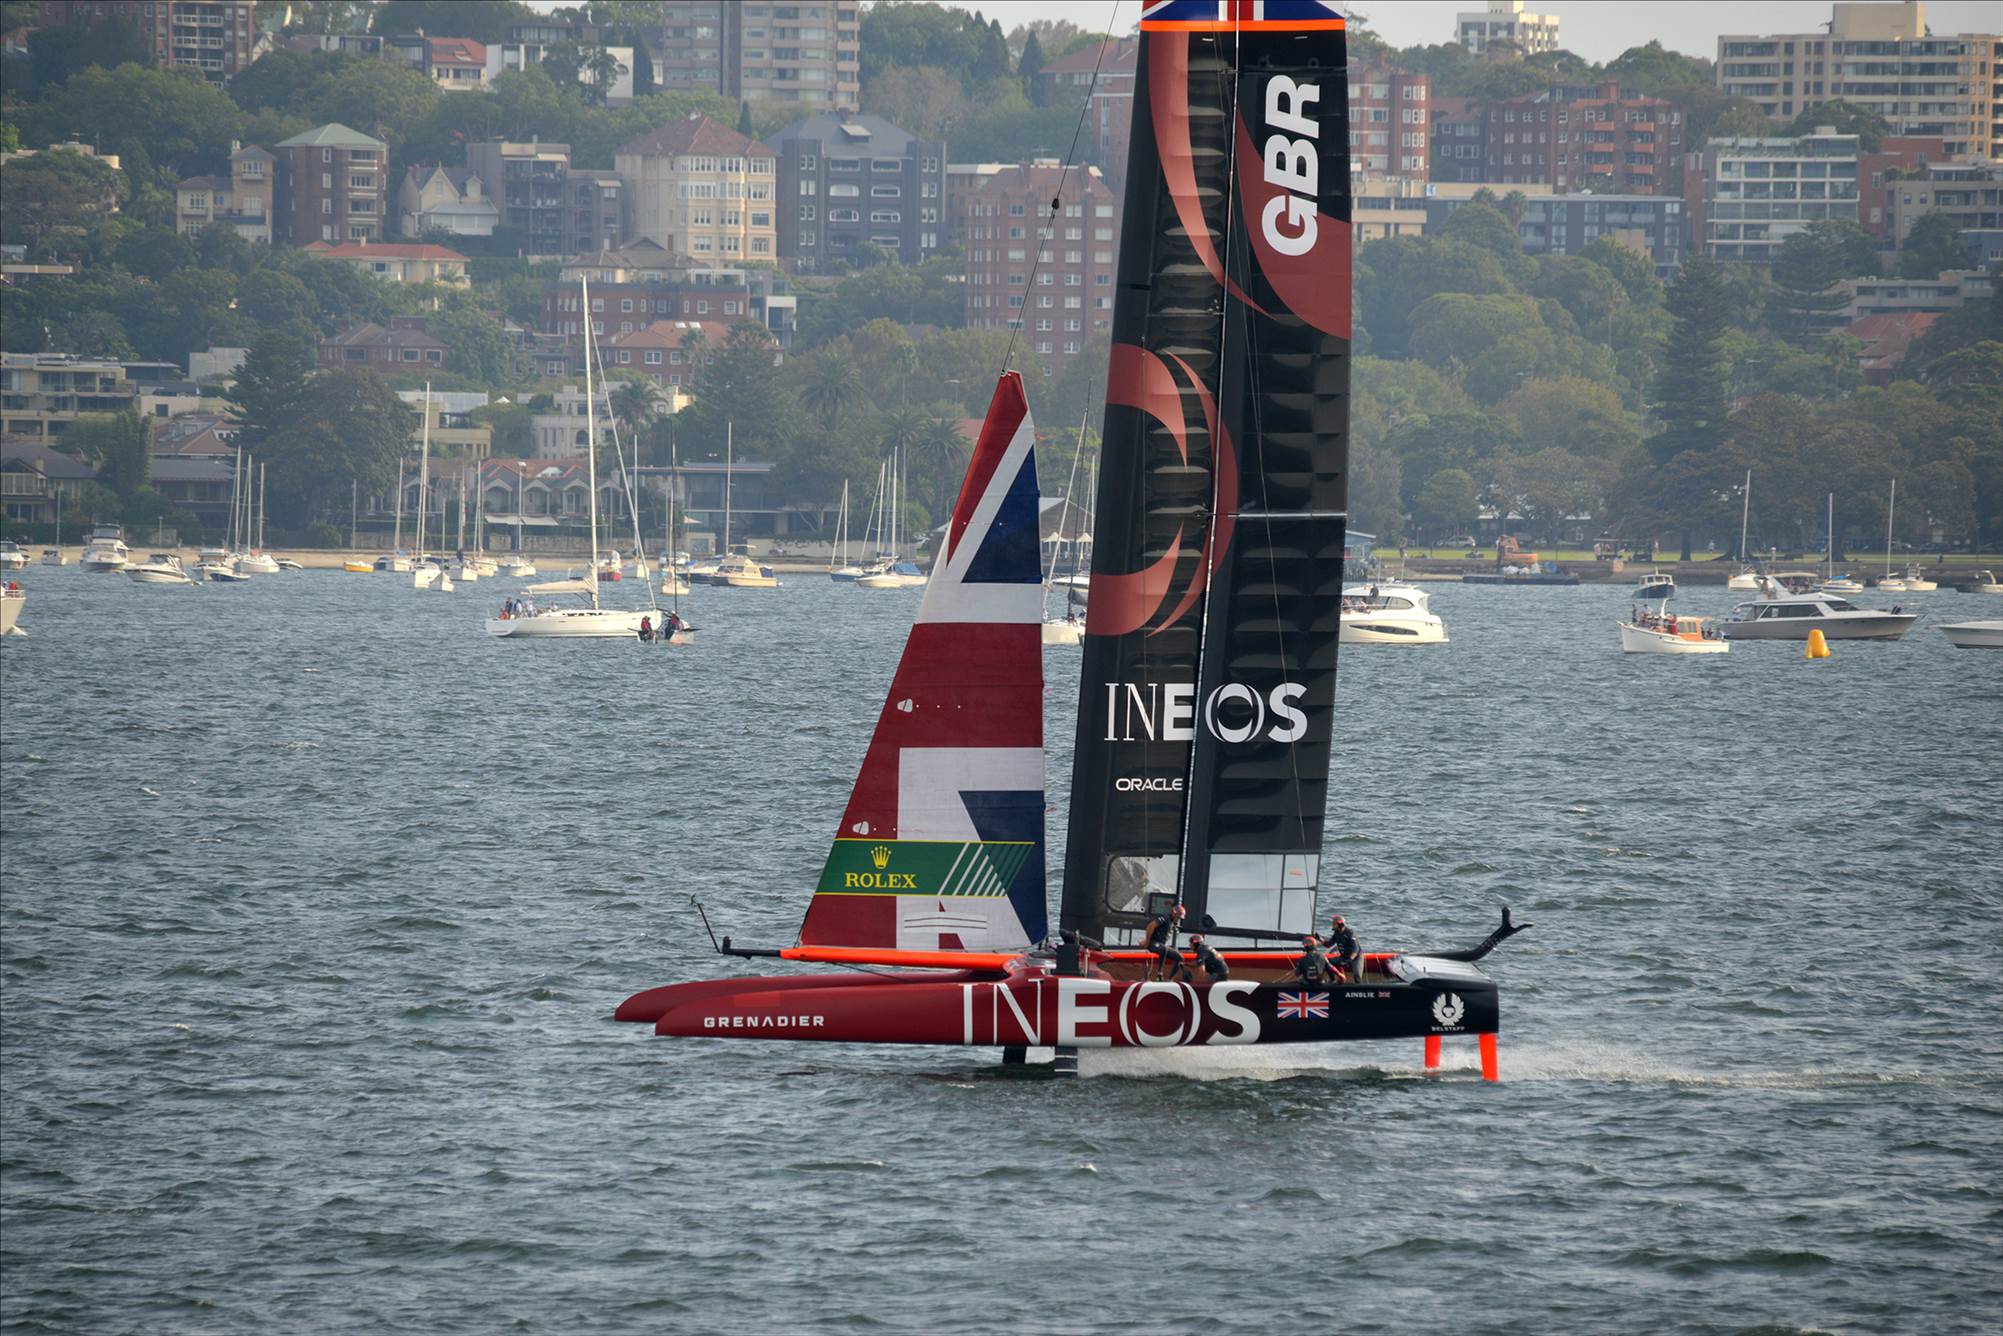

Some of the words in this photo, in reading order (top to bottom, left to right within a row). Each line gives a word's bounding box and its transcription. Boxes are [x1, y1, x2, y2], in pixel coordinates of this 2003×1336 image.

[1261, 74, 1321, 256] GBR
[1103, 682, 1308, 744] INEOS
[1115, 777, 1184, 792] ORACLE
[844, 872, 918, 889] ROLEX
[703, 1015, 825, 1028] GRENADIER
[957, 978, 1262, 1048] INEOS
